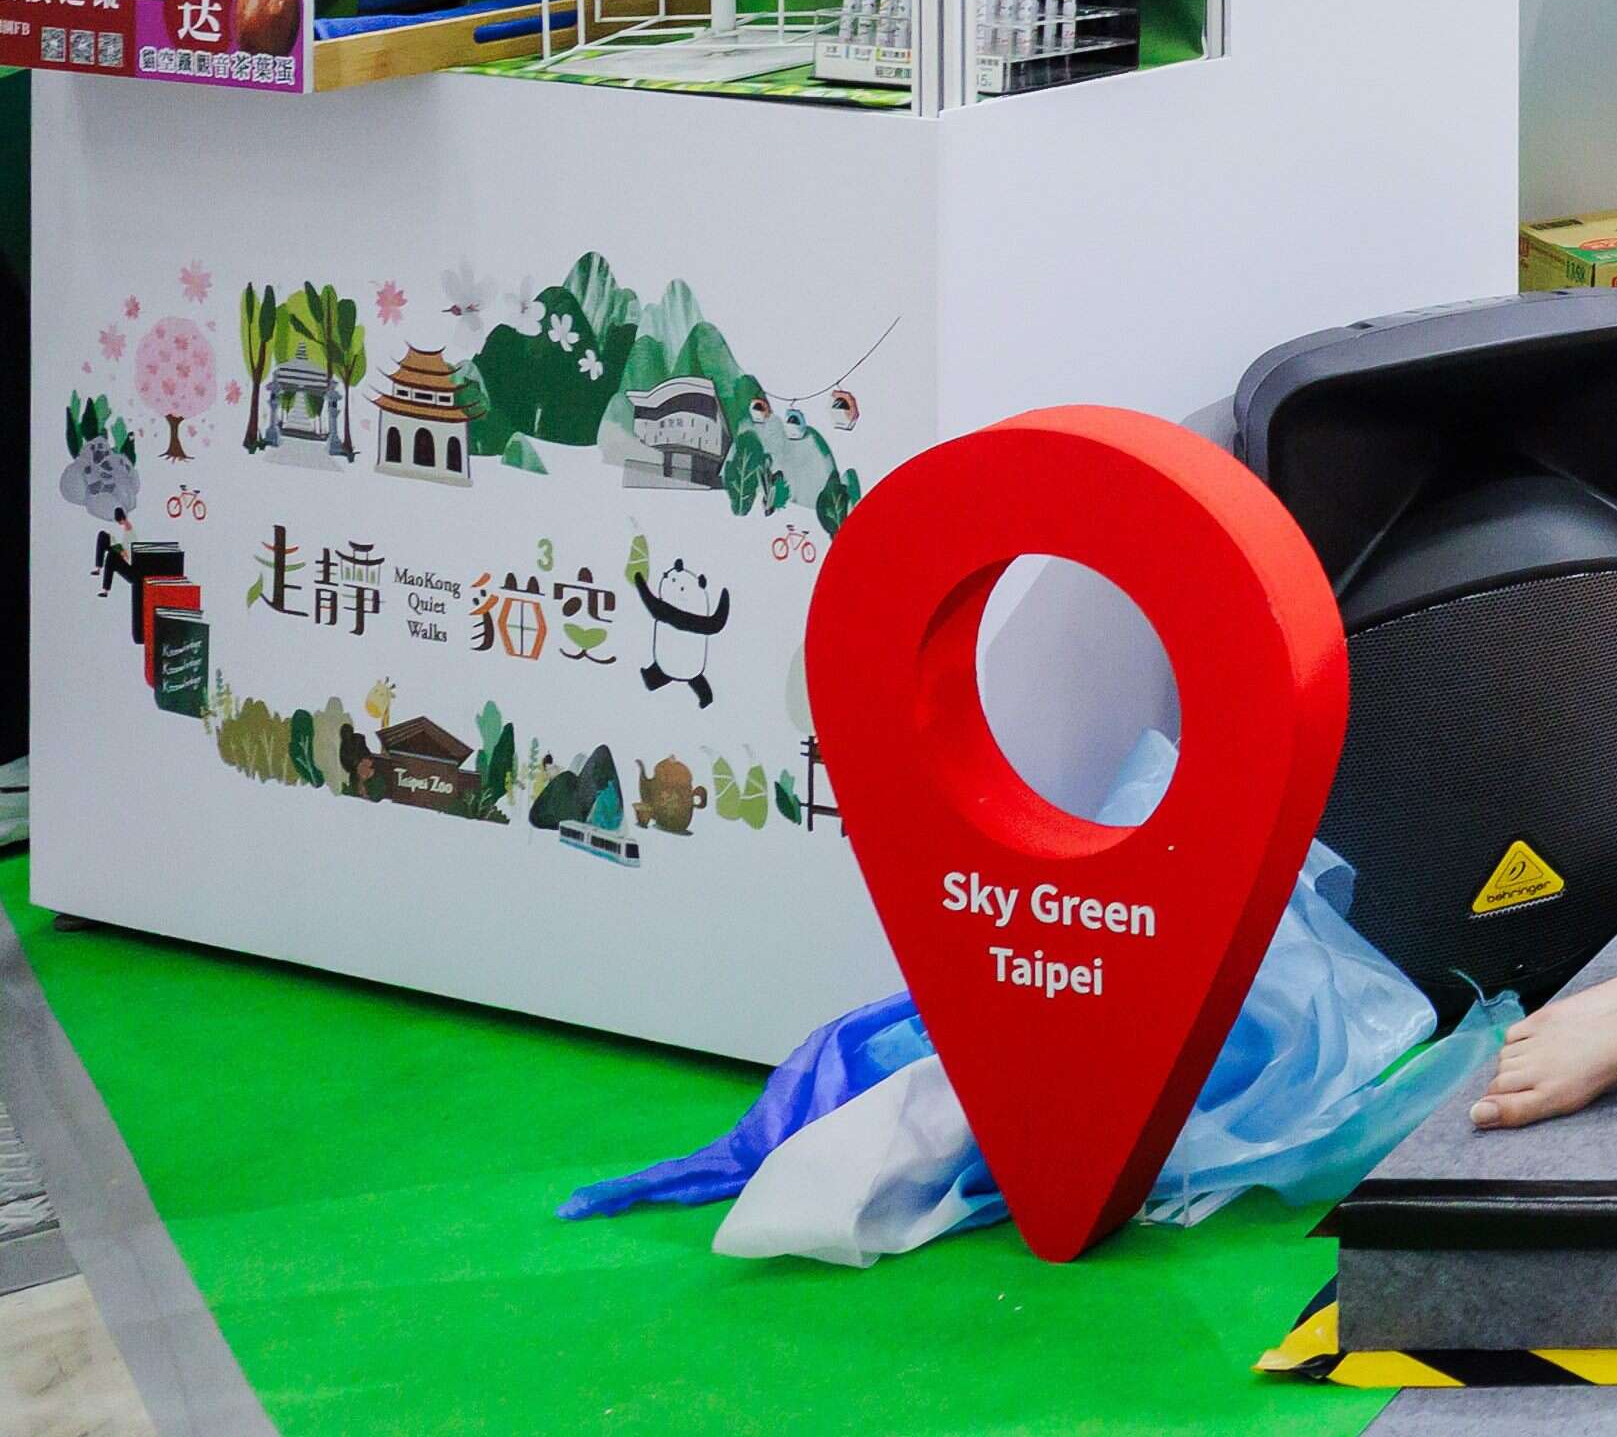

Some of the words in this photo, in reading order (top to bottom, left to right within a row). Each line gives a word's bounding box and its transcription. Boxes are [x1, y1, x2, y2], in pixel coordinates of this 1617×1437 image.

[394, 566, 462, 599] MaoKong
[407, 592, 447, 616] Quiet
[406, 619, 448, 644] Walks
[429, 775, 454, 795] Zoo
[942, 871, 1019, 928] Sky
[1030, 883, 1156, 937] Green
[1486, 880, 1551, 904] behringer
[989, 945, 1103, 999] Taipei
